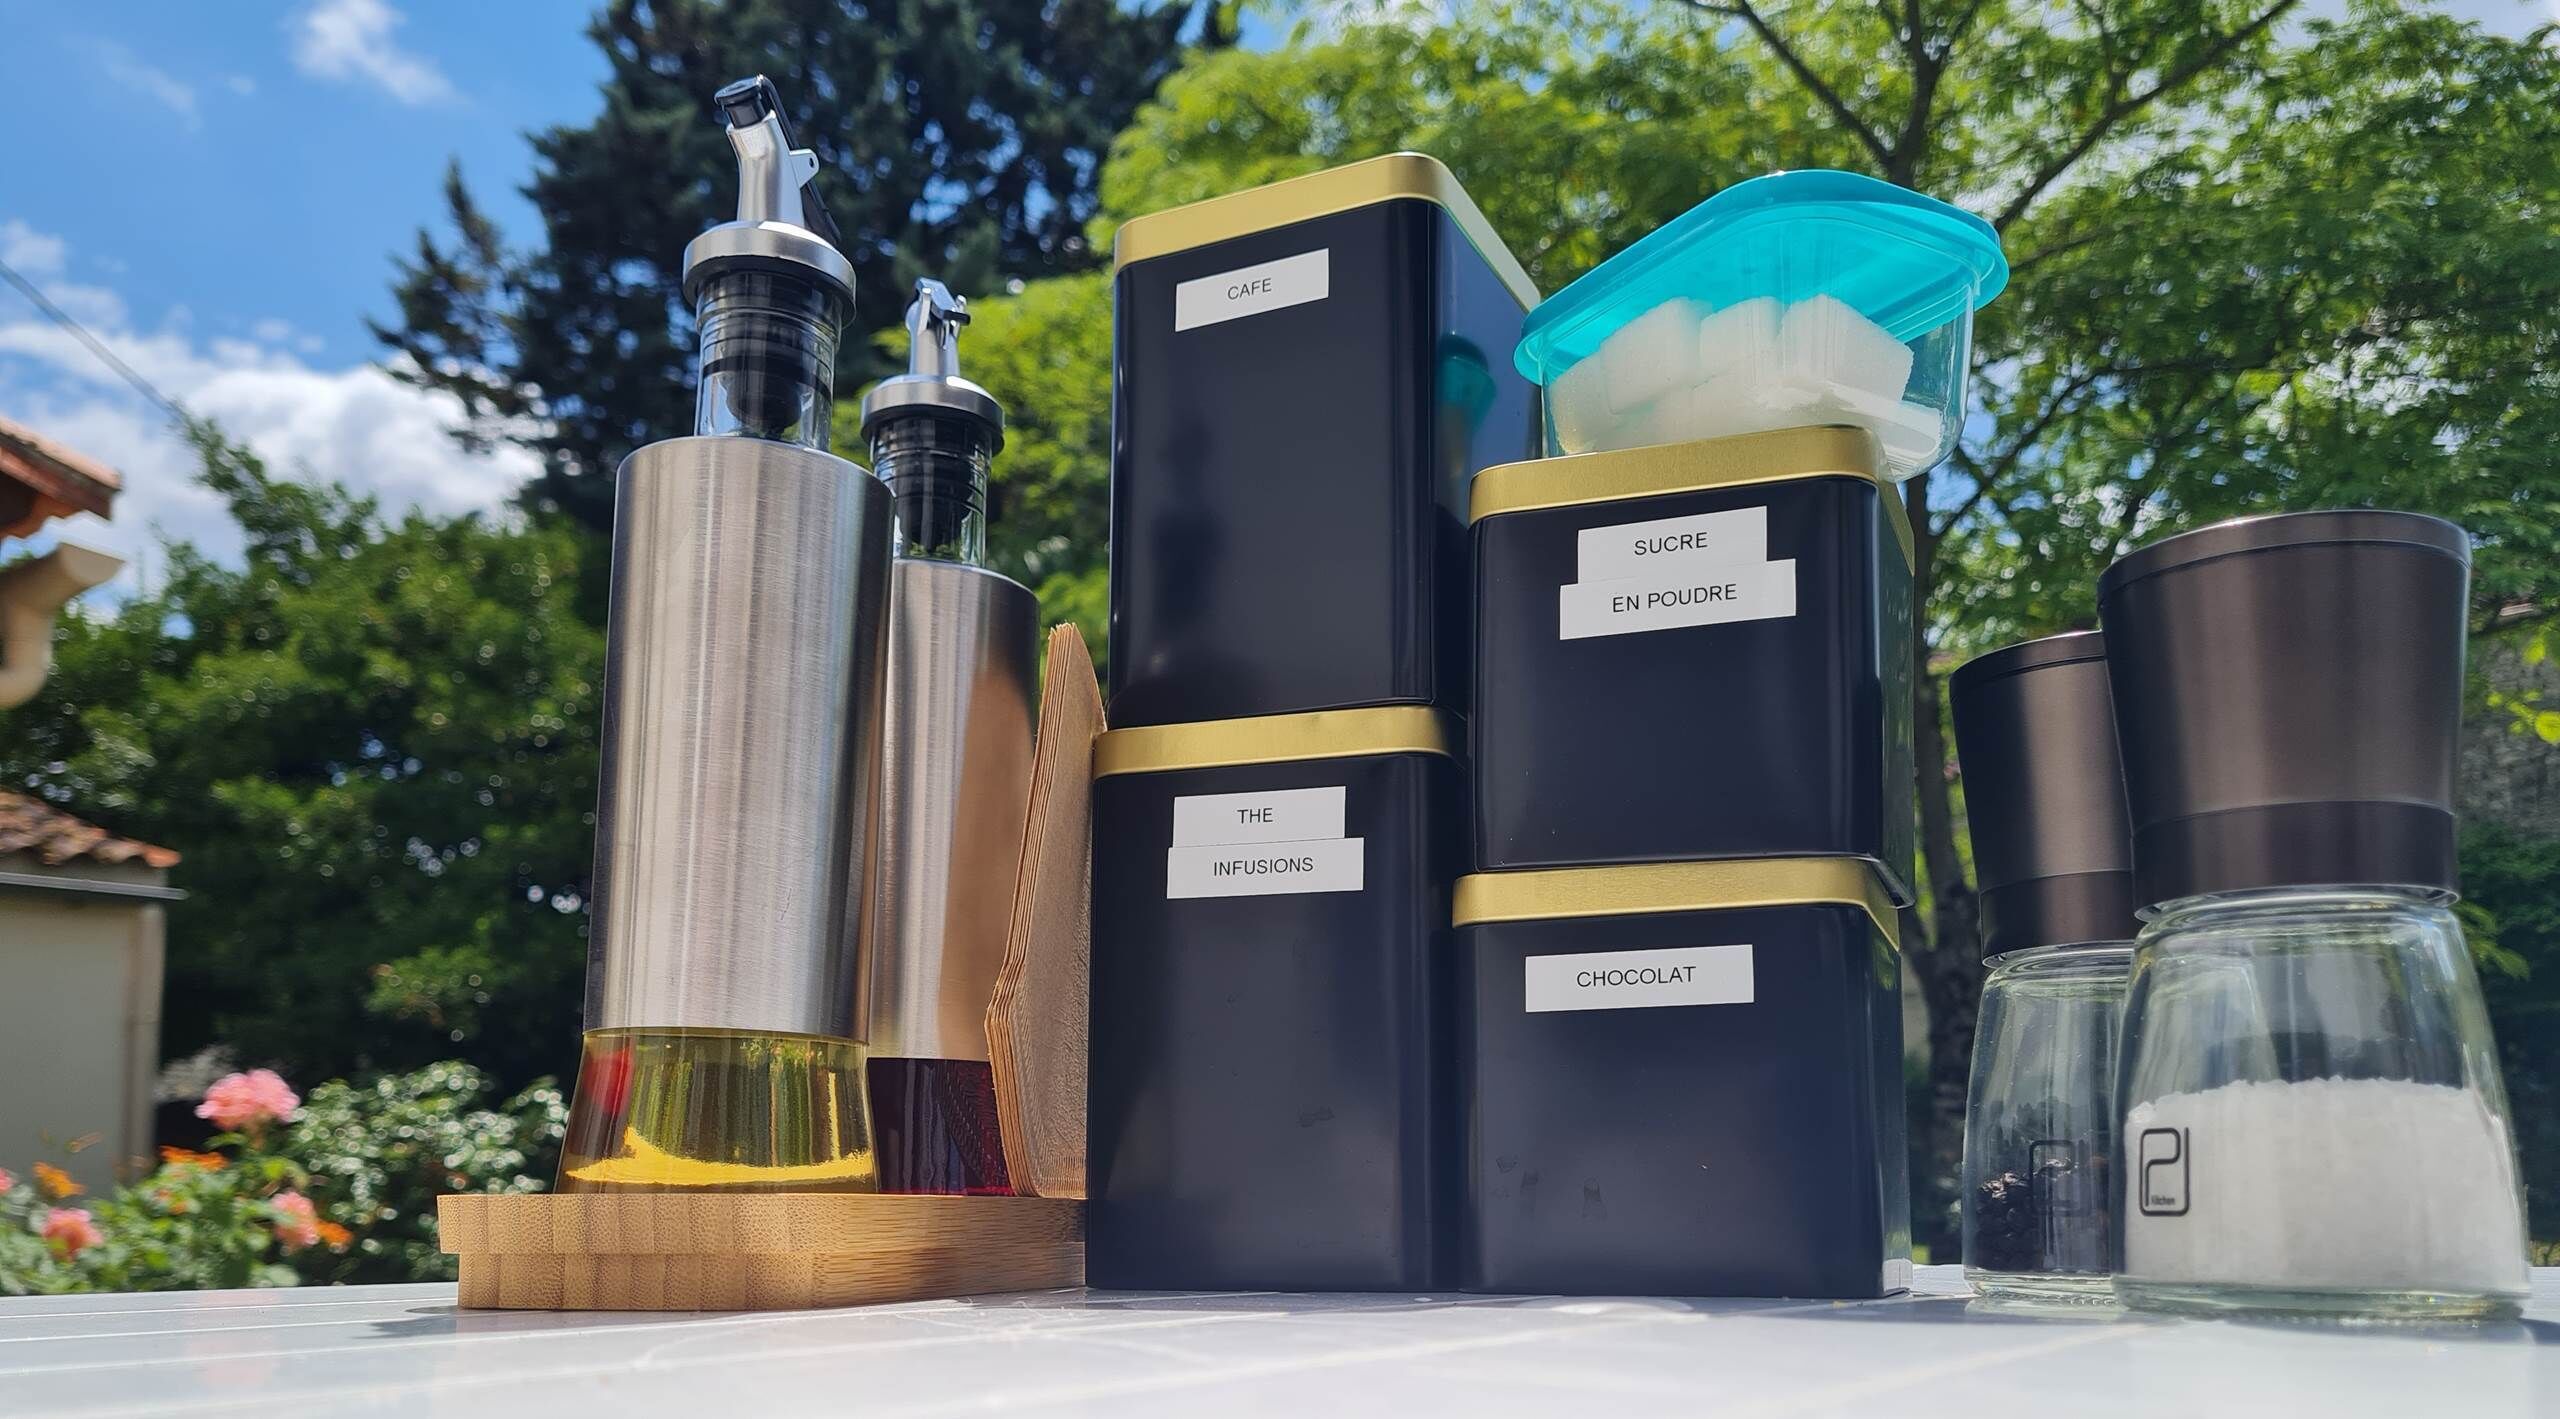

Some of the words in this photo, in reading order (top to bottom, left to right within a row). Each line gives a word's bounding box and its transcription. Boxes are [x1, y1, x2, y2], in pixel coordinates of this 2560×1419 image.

[1227, 277, 1272, 300] CAFE
[1634, 532, 1708, 556] SUCRE
[1612, 595, 1640, 613] EN
[1648, 584, 1738, 609] POUDRE
[1237, 807, 1273, 824] THE
[1213, 857, 1314, 877] INFUSIONS
[1576, 966, 1697, 987] CHOCOLAT
